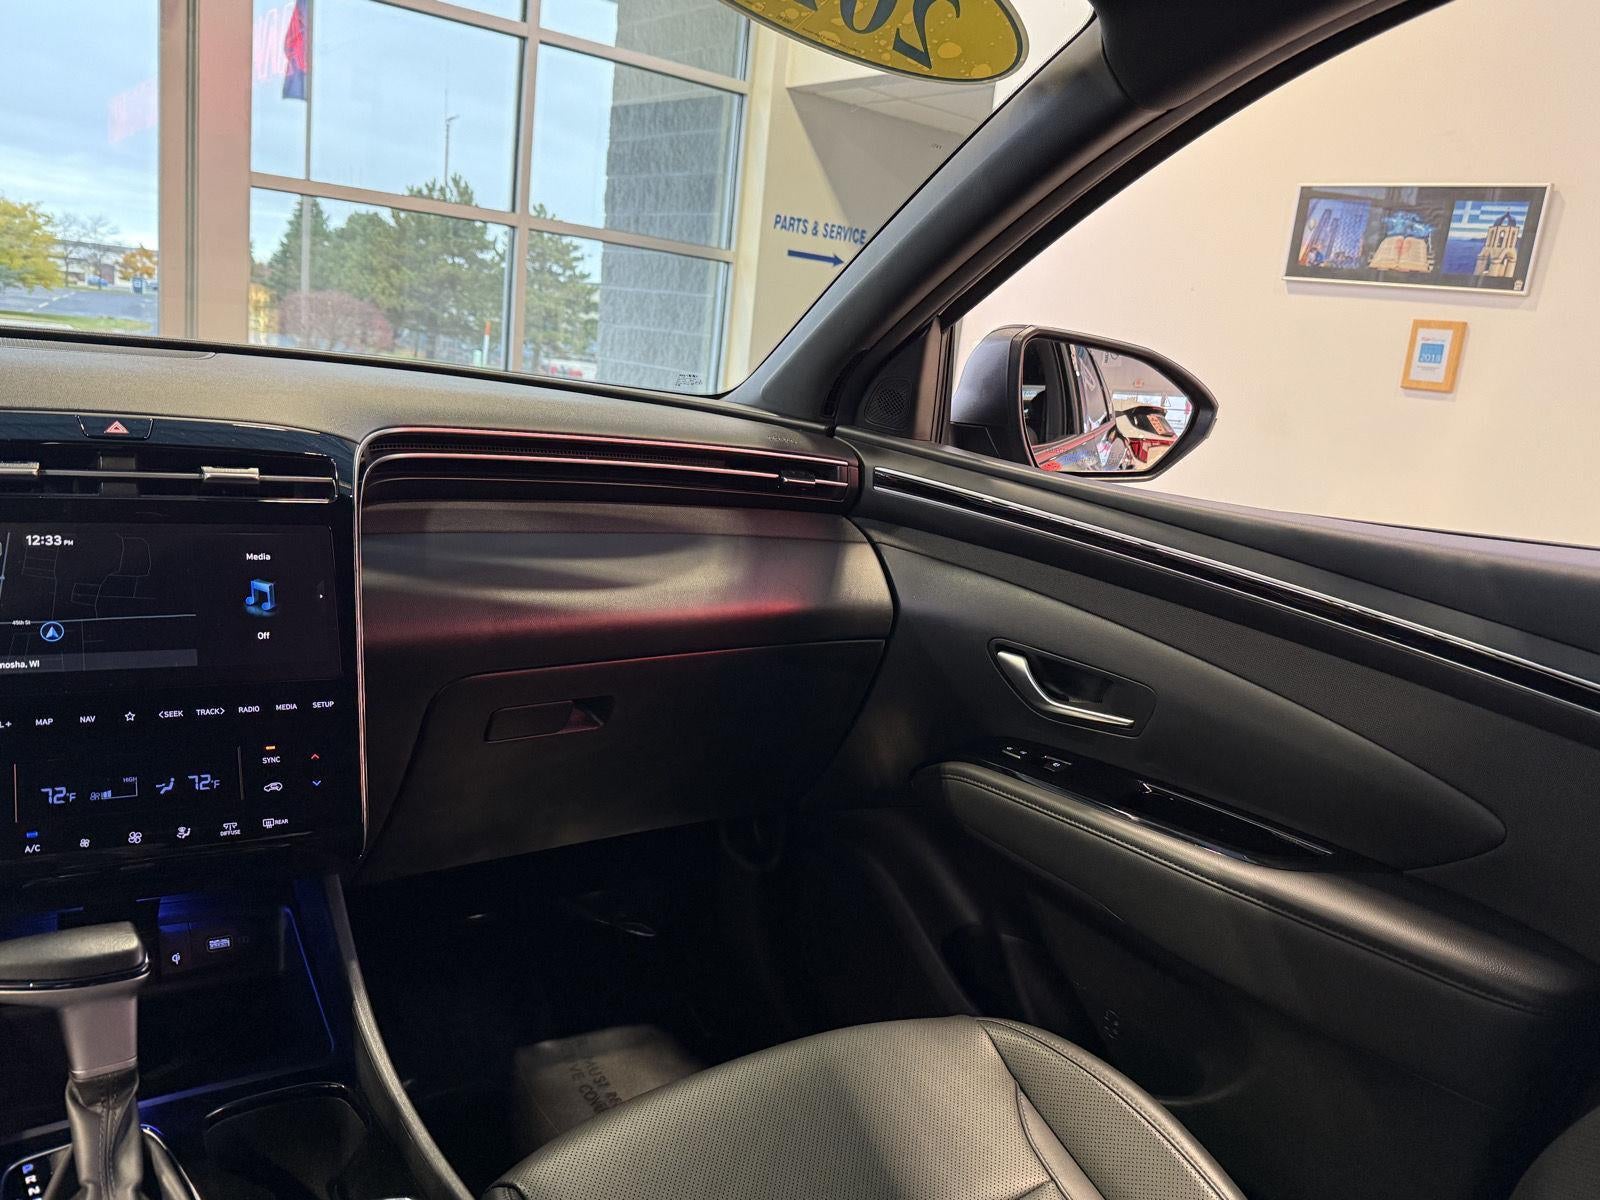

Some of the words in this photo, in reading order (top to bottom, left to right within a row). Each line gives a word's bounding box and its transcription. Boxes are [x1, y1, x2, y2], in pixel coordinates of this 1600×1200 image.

[773, 214, 809, 235] PARTS
[812, 220, 819, 237] &
[822, 222, 868, 245] SERVICE
[25, 534, 62, 546] 12:33
[246, 552, 271, 561] Media
[257, 631, 271, 640] Off
[238, 705, 260, 714] RADIO
[276, 703, 298, 712] MEDIA
[312, 701, 334, 709] SETUP
[35, 717, 54, 727] MAP
[79, 715, 96, 724] NAV
[262, 756, 281, 764] SYNC
[219, 829, 241, 837] DIFFUSE
[24, 844, 41, 854] A/C
